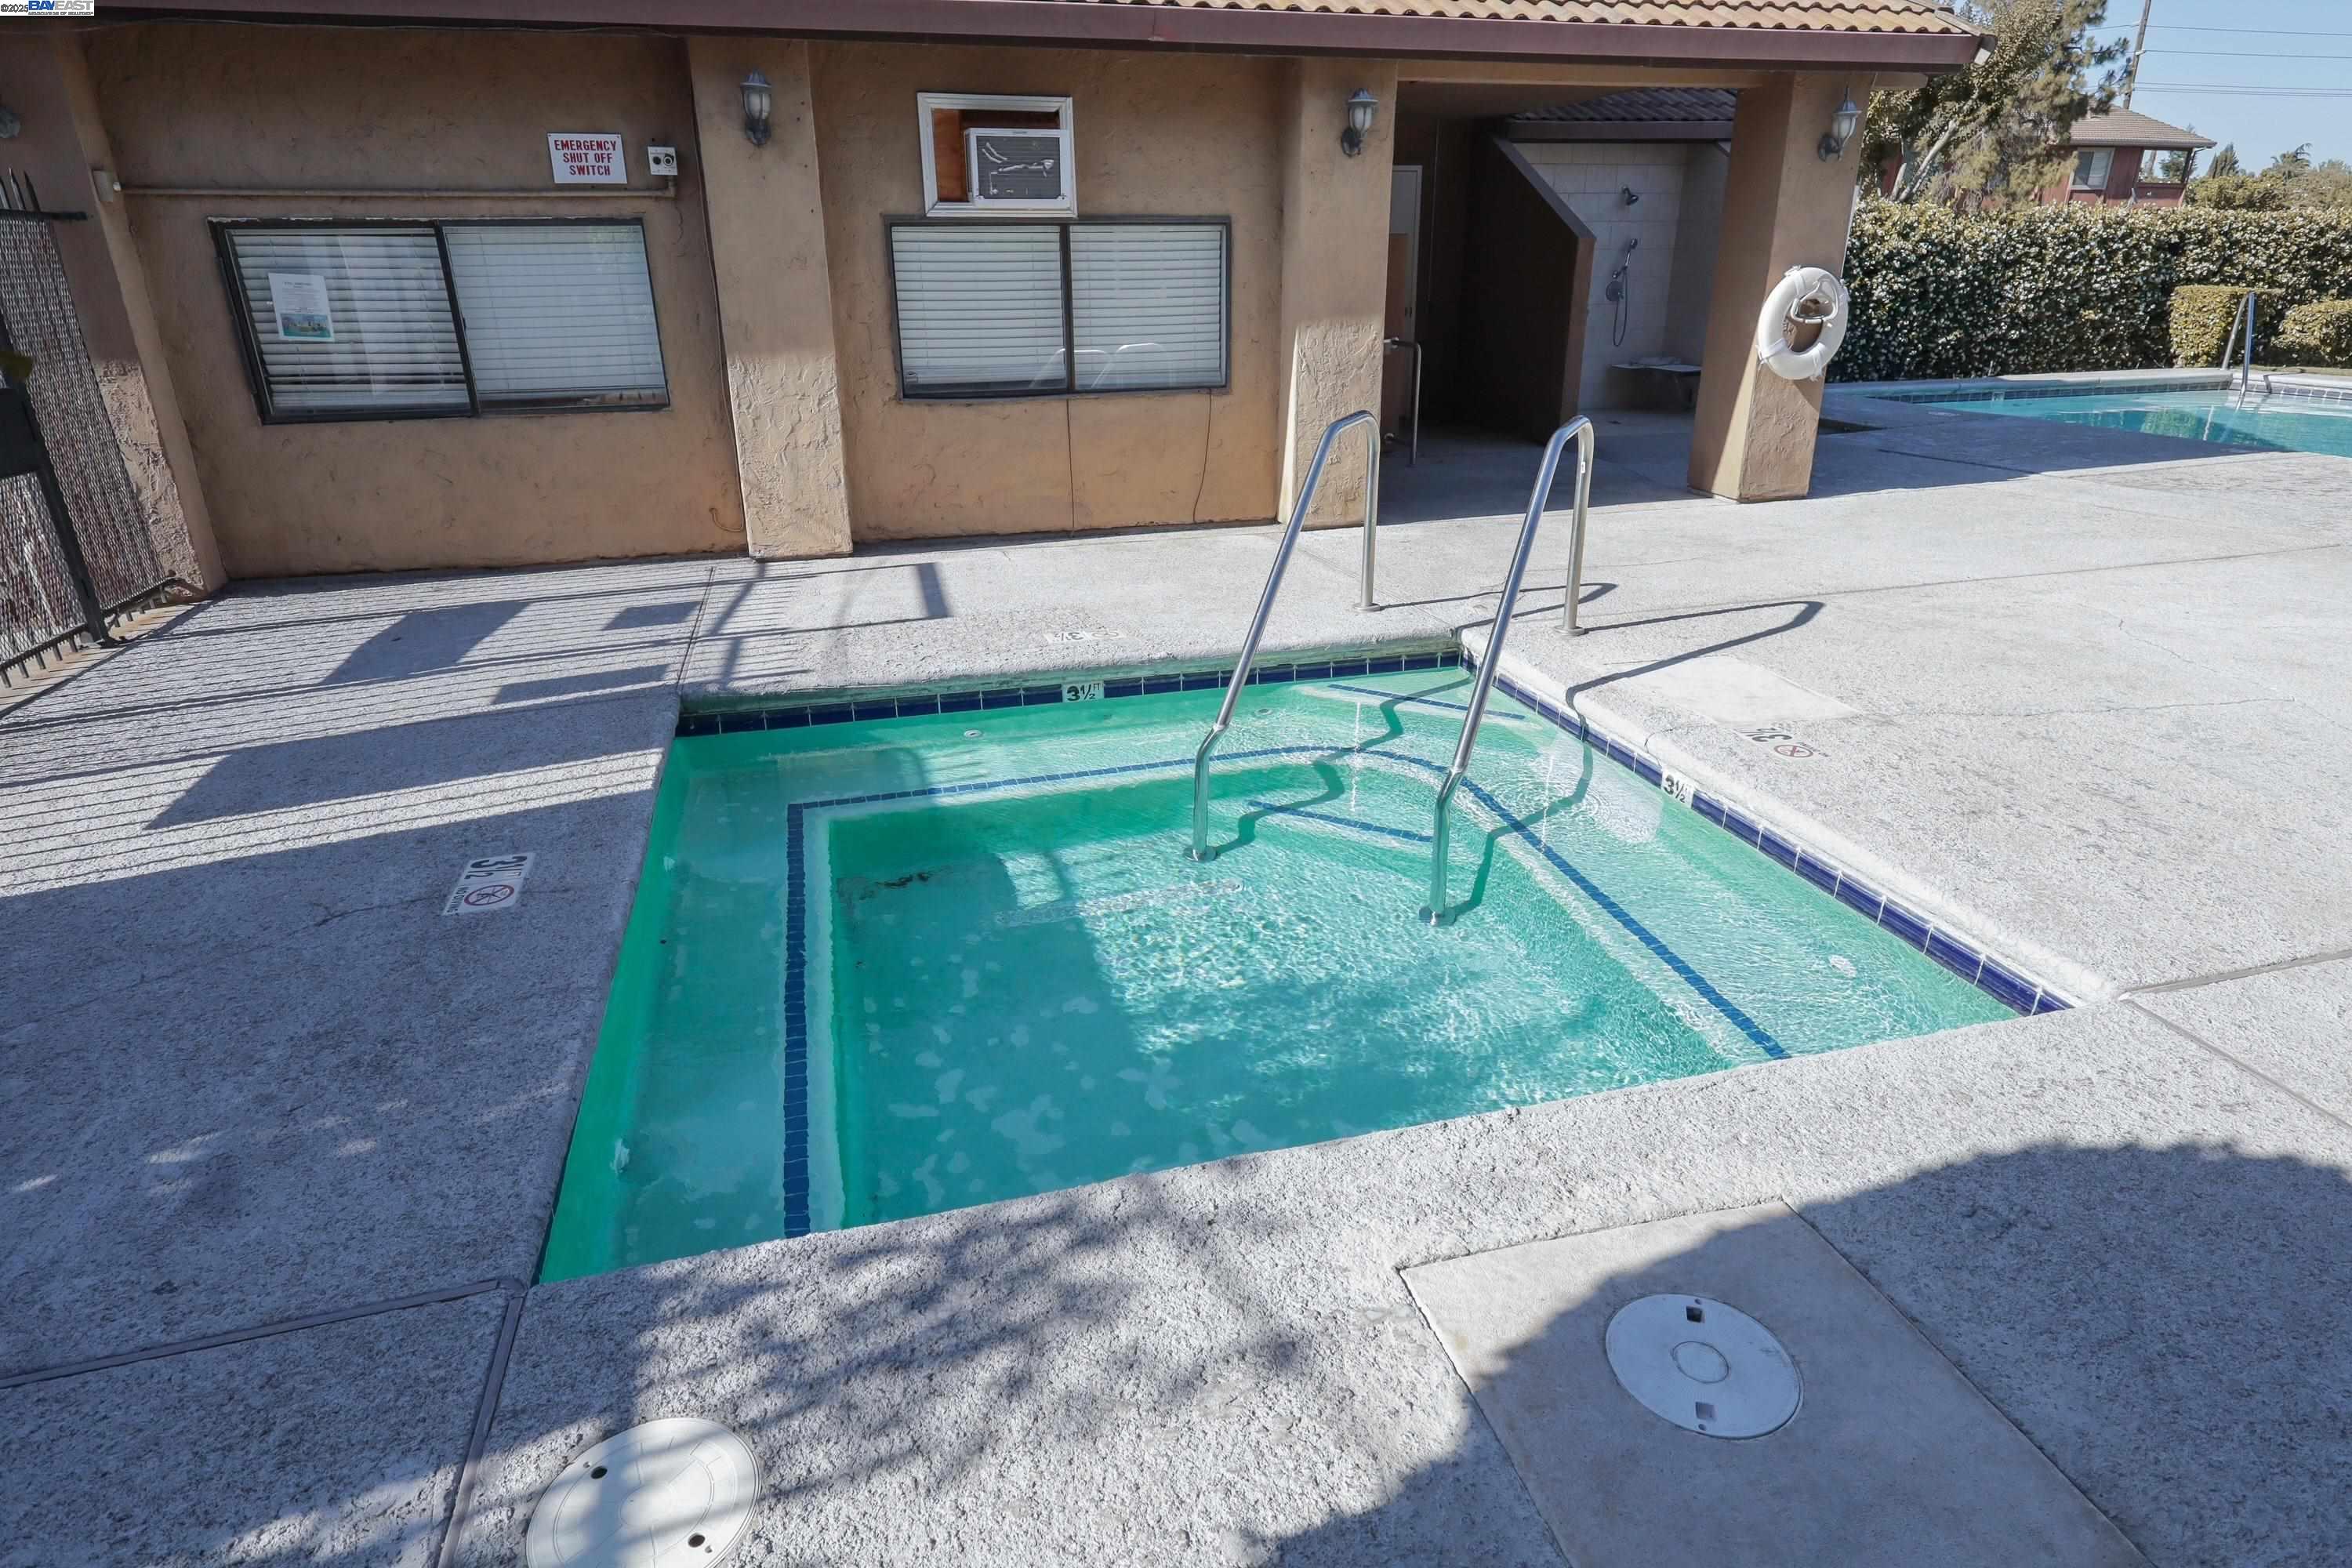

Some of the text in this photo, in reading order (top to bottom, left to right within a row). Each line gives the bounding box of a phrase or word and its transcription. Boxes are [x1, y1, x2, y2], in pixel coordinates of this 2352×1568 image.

[554, 140, 617, 151] EMERGENCY
[563, 153, 613, 163] SHUT OFF
[569, 165, 611, 176] SWITCH
